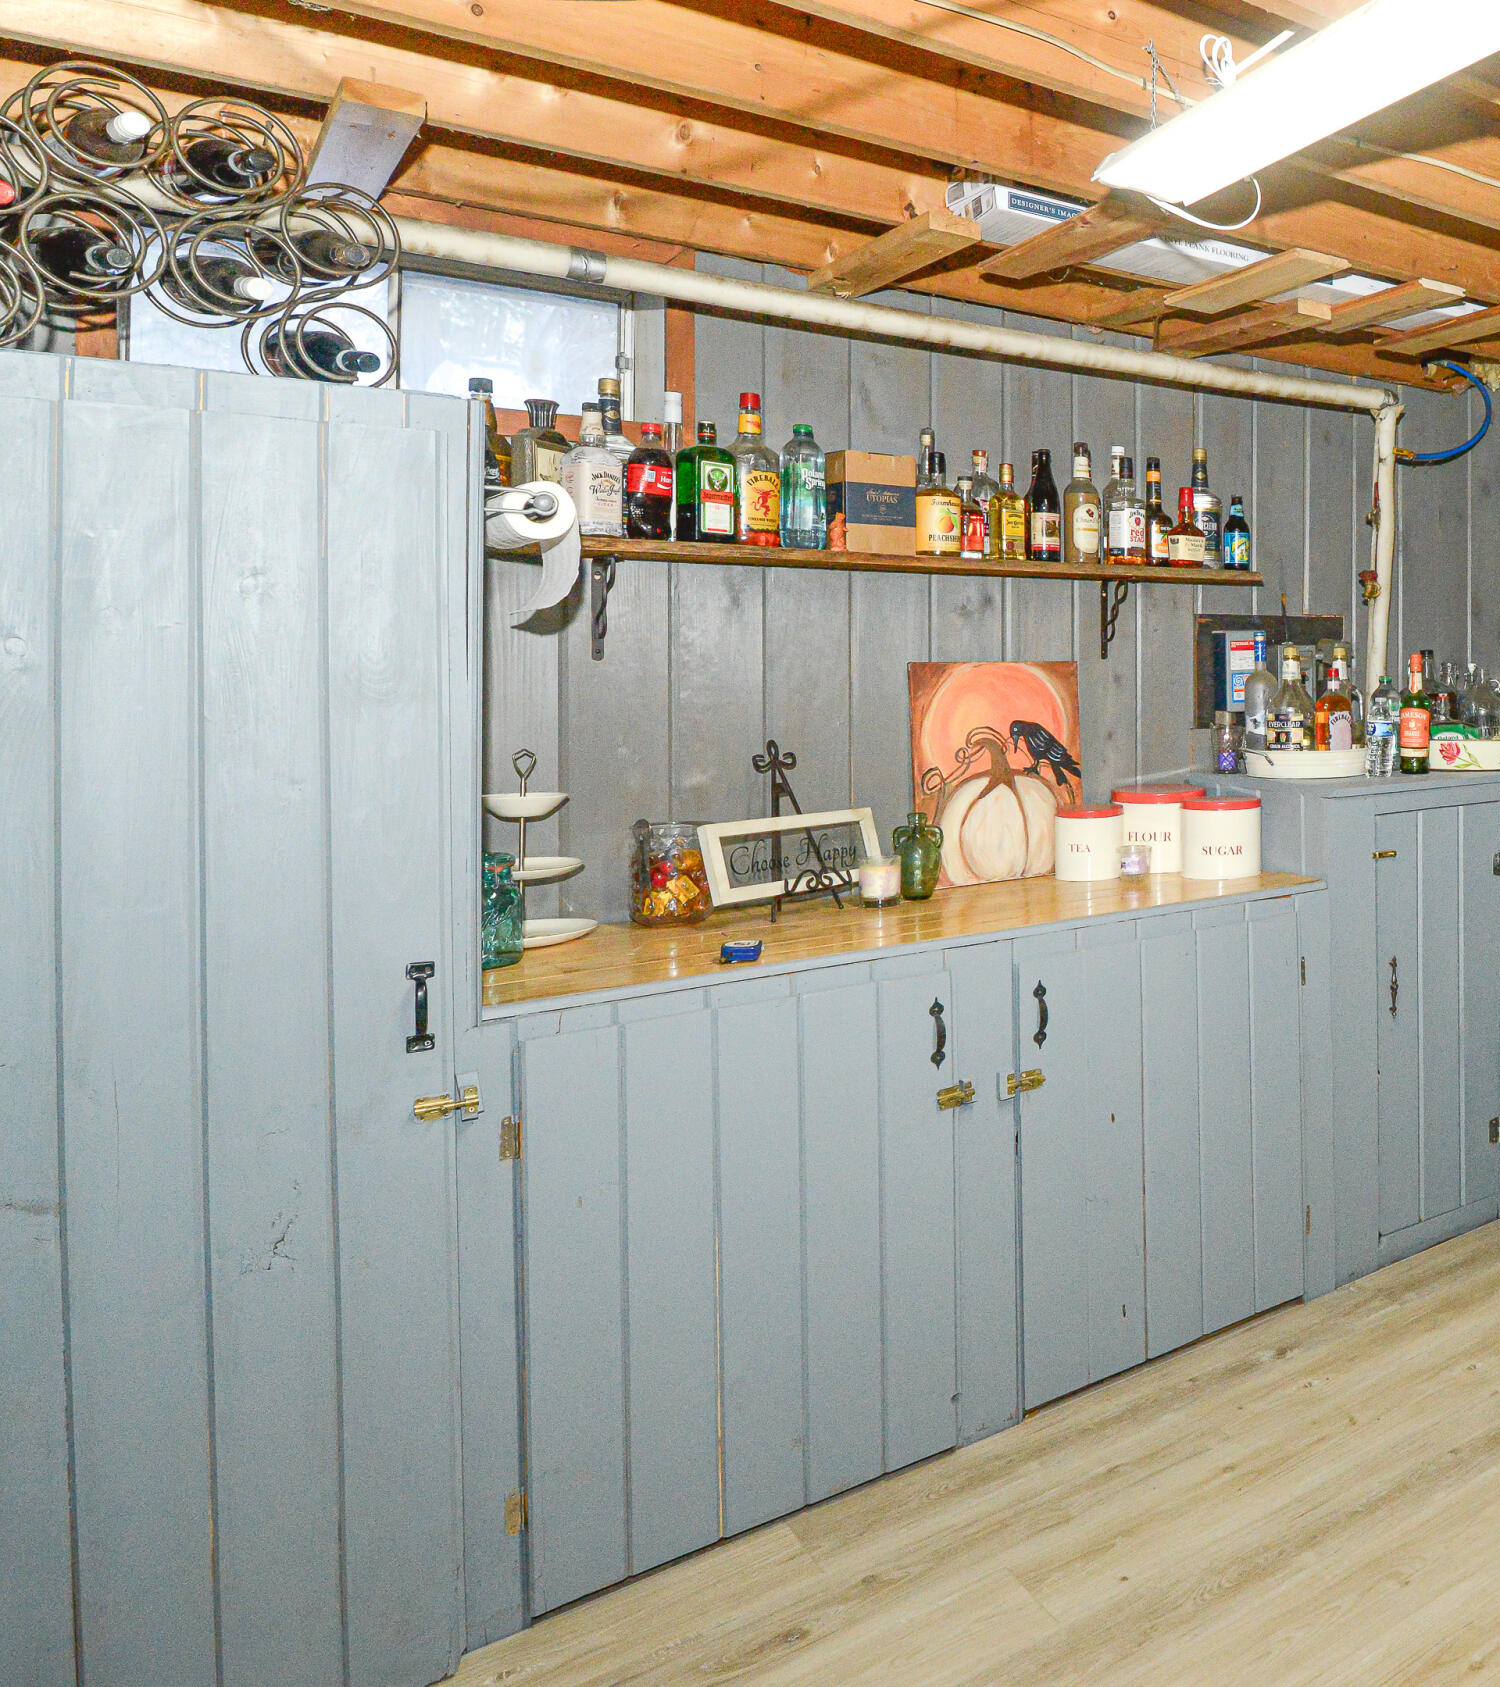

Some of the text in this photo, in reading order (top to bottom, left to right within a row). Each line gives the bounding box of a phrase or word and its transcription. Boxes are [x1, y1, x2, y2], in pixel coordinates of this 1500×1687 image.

[1011, 197, 1056, 215] DESIGNER'S
[1211, 246, 1249, 262] FLOORING
[747, 474, 780, 489] FIREBALL
[866, 494, 898, 504] UTOPIAS
[1130, 528, 1144, 536] red
[1400, 711, 1427, 720] JAMESON
[1128, 831, 1173, 843] FLOUR
[1068, 843, 1091, 853] TEA
[1201, 845, 1244, 856] SUGAR
[730, 832, 857, 876] Choose Happy
